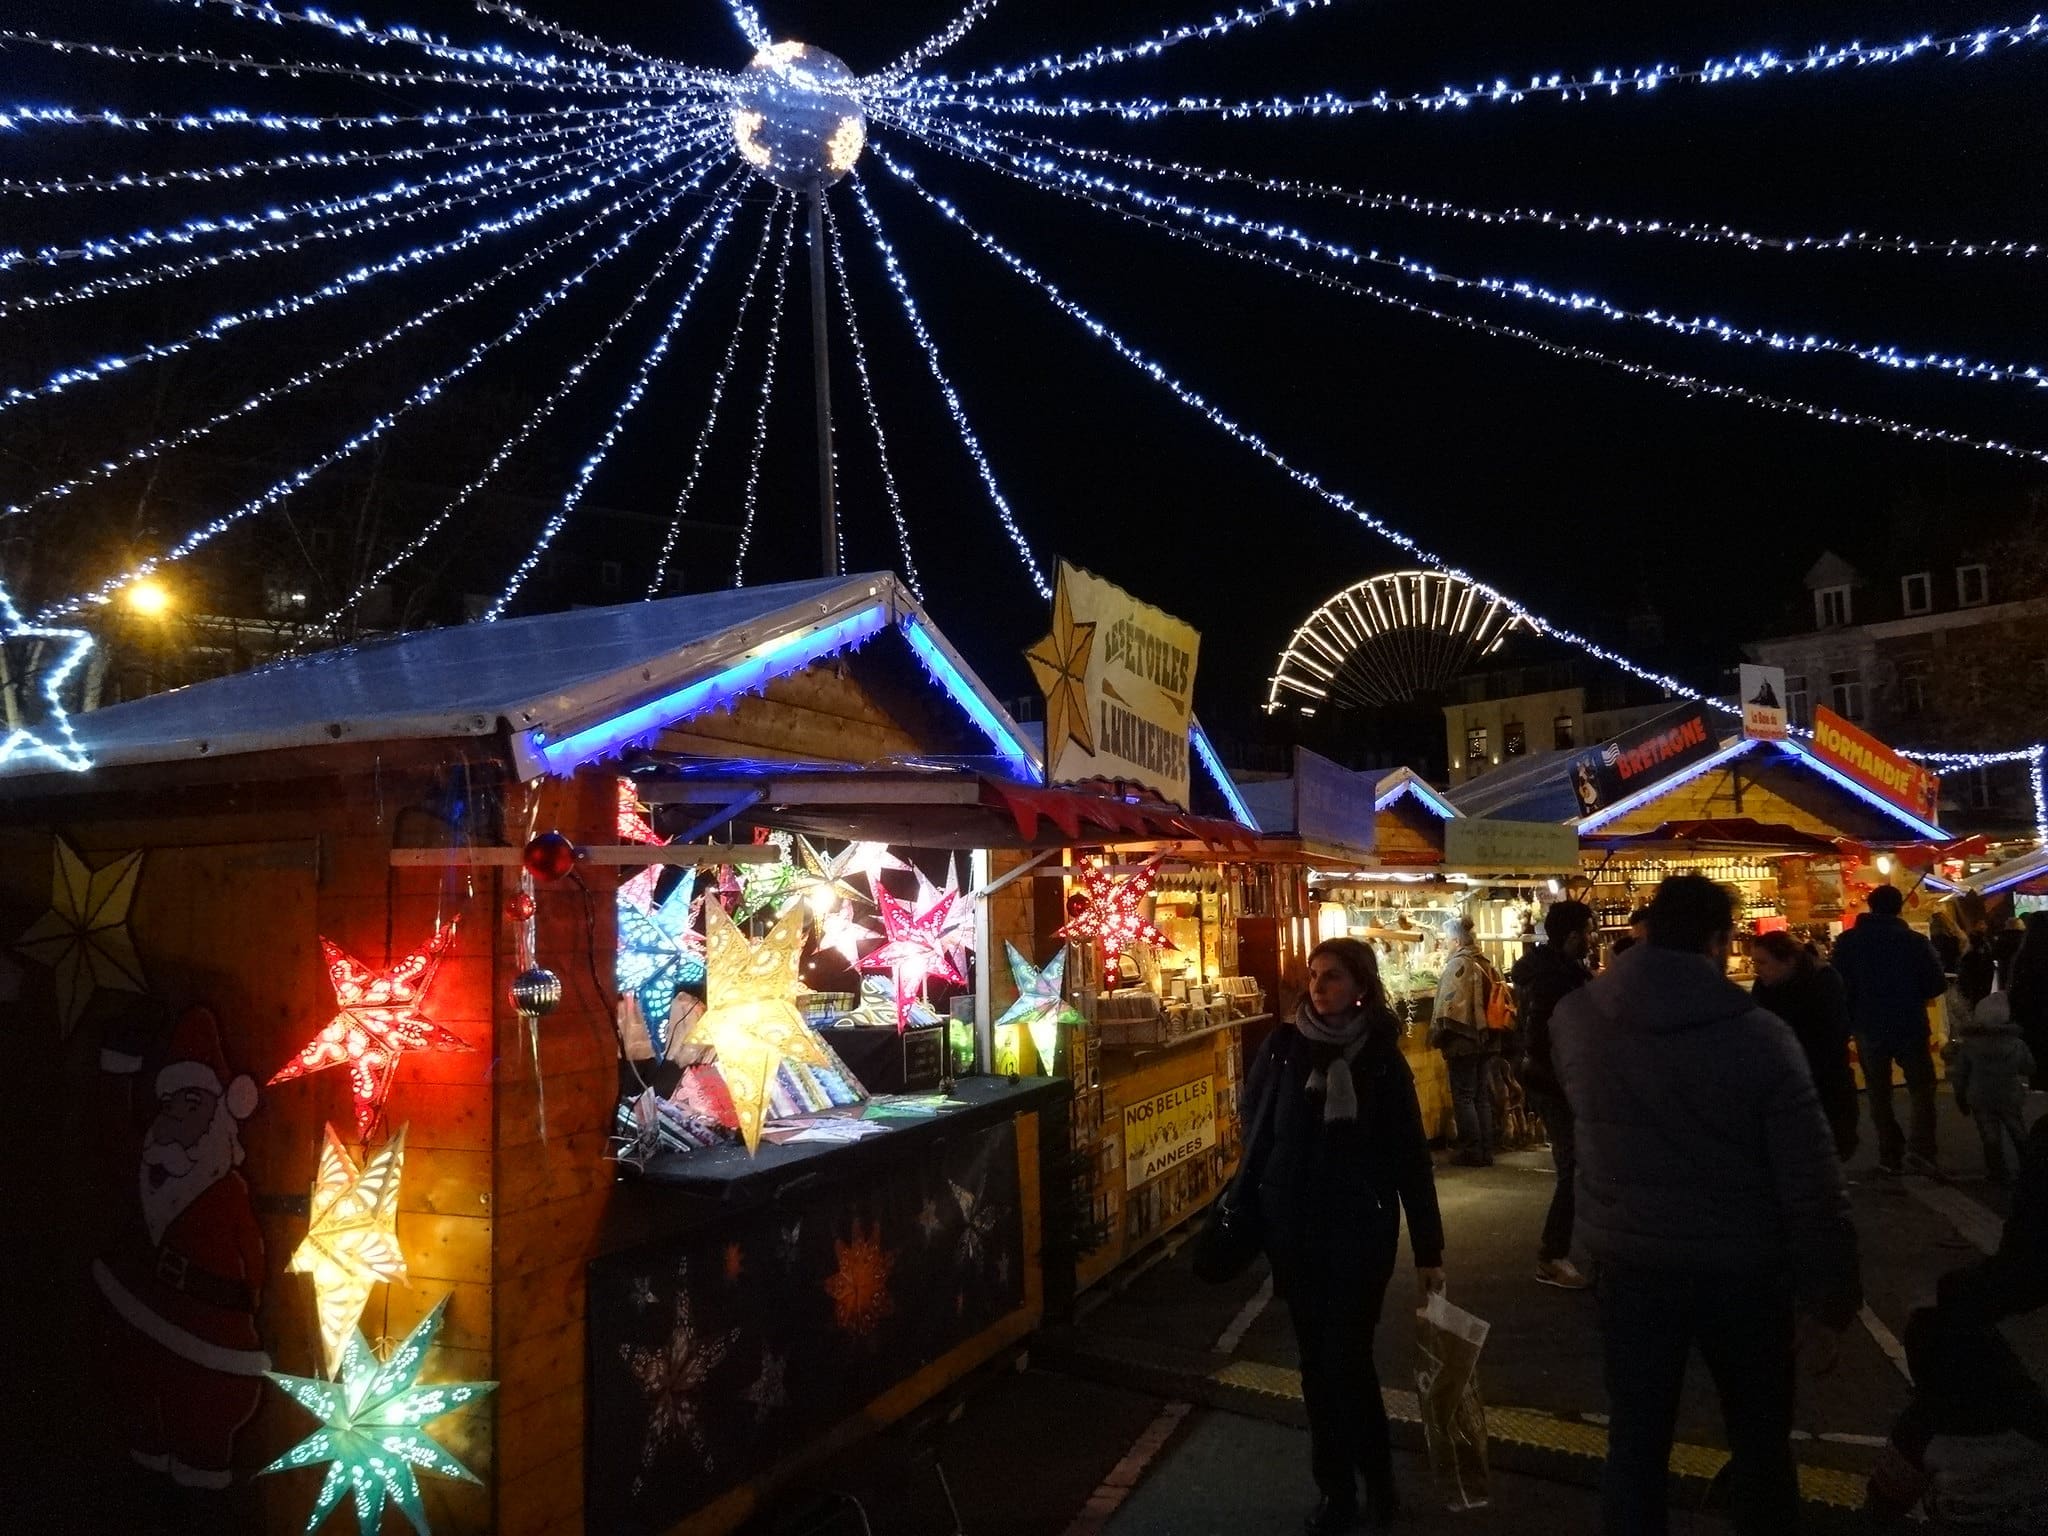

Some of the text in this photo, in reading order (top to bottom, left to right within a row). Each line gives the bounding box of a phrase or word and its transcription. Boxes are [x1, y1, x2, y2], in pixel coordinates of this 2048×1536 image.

[1617, 715, 1706, 780] BRETAGNE
[1816, 719, 1911, 796] NORMANDIE
[1127, 1080, 1208, 1126] NOS BELLES
[1146, 1137, 1202, 1177] ANNEES
